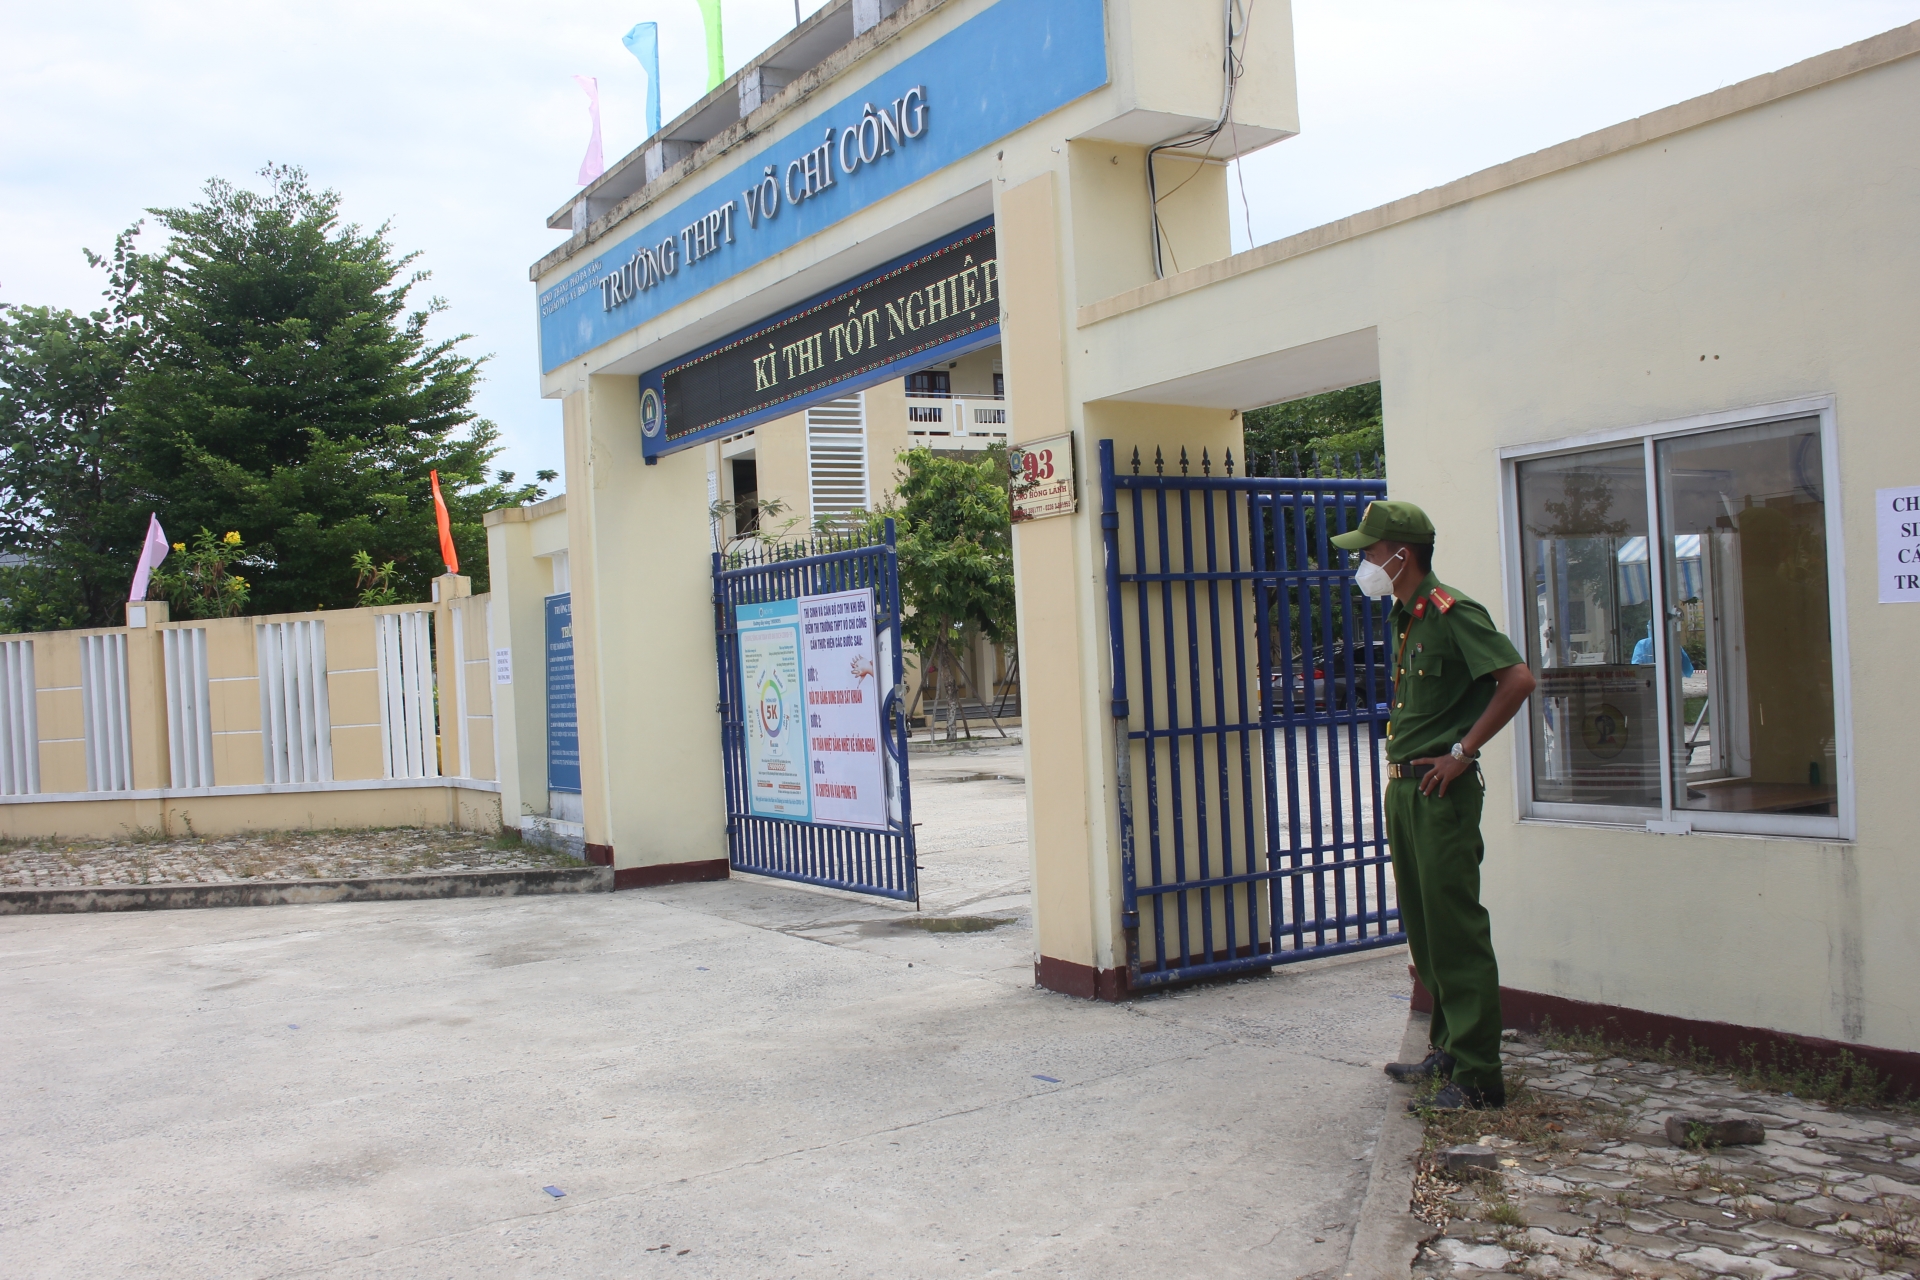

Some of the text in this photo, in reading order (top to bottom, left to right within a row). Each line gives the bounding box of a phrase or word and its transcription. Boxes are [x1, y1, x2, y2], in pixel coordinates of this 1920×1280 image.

[599, 85, 929, 312] TRƯỜNG THPT VÕ CHÍ CÔNG
[752, 254, 999, 392] KÌ THI TỐT NGHIỆP
[1023, 449, 1054, 482] 93
[1901, 522, 1920, 538] SI
[810, 606, 818, 618] SINH
[818, 604, 824, 617] VÀ
[831, 602, 837, 617] BỘ
[857, 597, 866, 612] ĐẾN
[804, 619, 814, 634] ĐIỂM
[819, 618, 833, 633] TRƯỜNG
[833, 619, 843, 632] THPT
[843, 617, 848, 630] VÕ
[848, 616, 856, 630] CHÍ
[856, 615, 867, 629] CÔNG
[826, 636, 835, 651] HIỆN
[843, 634, 853, 647] BƯỚC
[766, 705, 778, 720] 5K
